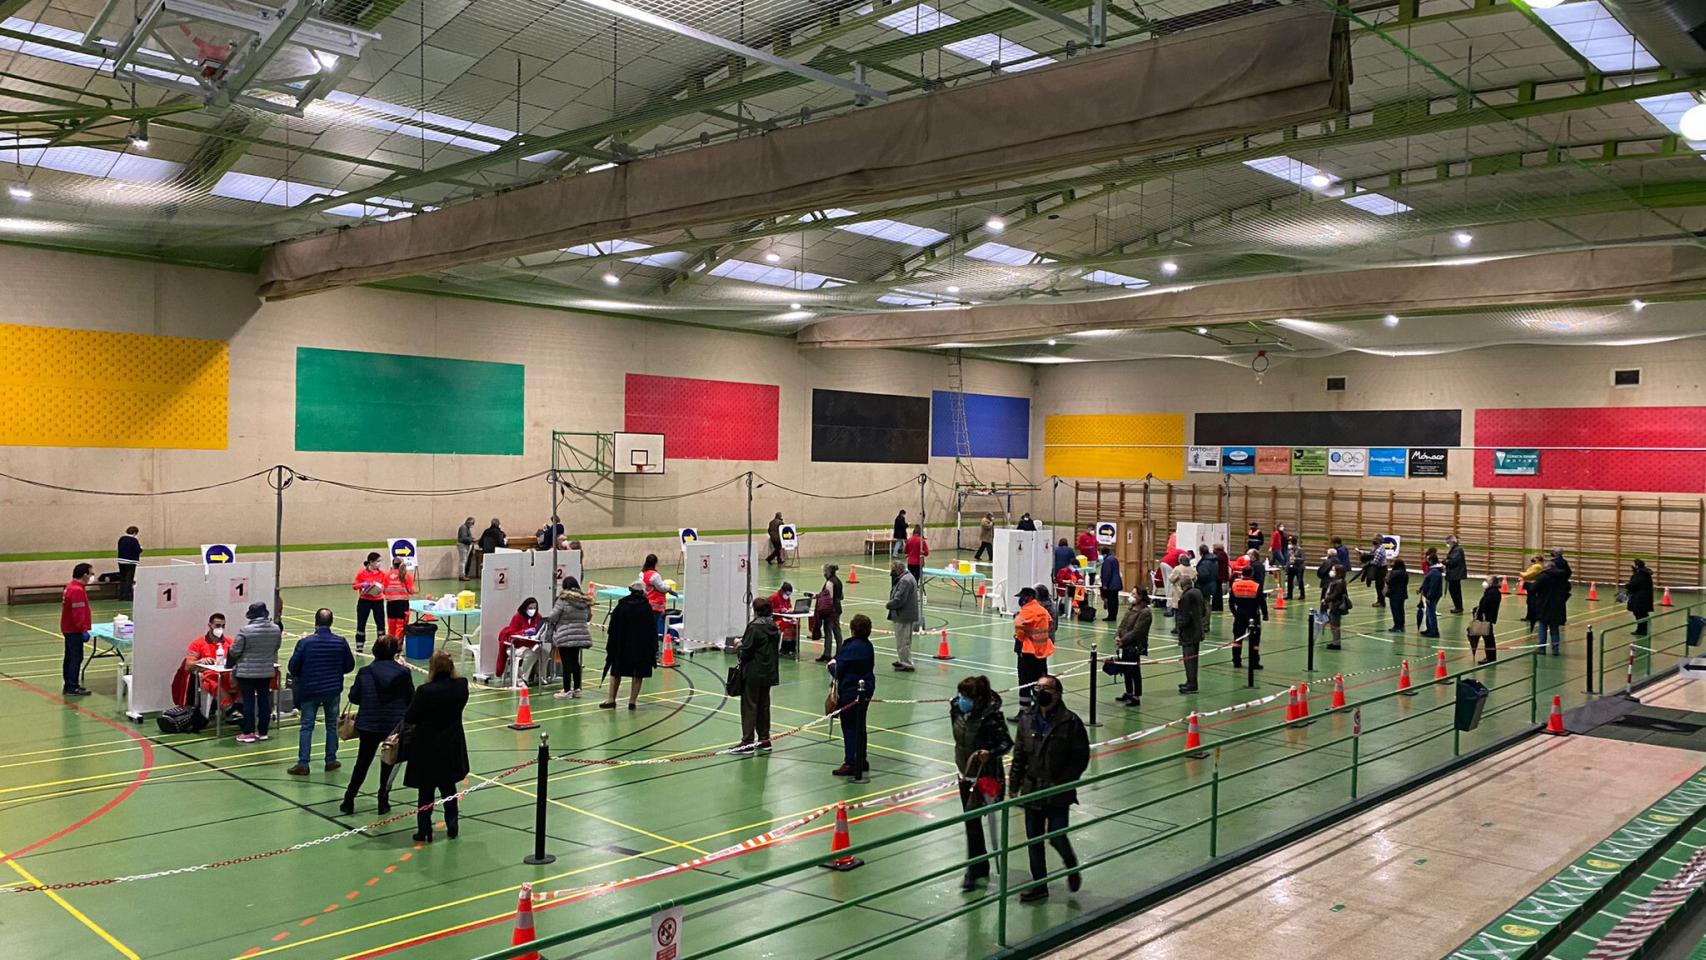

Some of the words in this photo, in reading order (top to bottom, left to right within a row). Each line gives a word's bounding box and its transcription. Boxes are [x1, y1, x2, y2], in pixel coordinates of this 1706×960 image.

[1411, 450, 1445, 460] Mónaco
[703, 559, 708, 569] 3
[740, 558, 746, 568] 3
[499, 573, 505, 584] 2
[556, 569, 563, 580] 2
[163, 588, 172, 601] 1
[235, 583, 244, 597] 1
